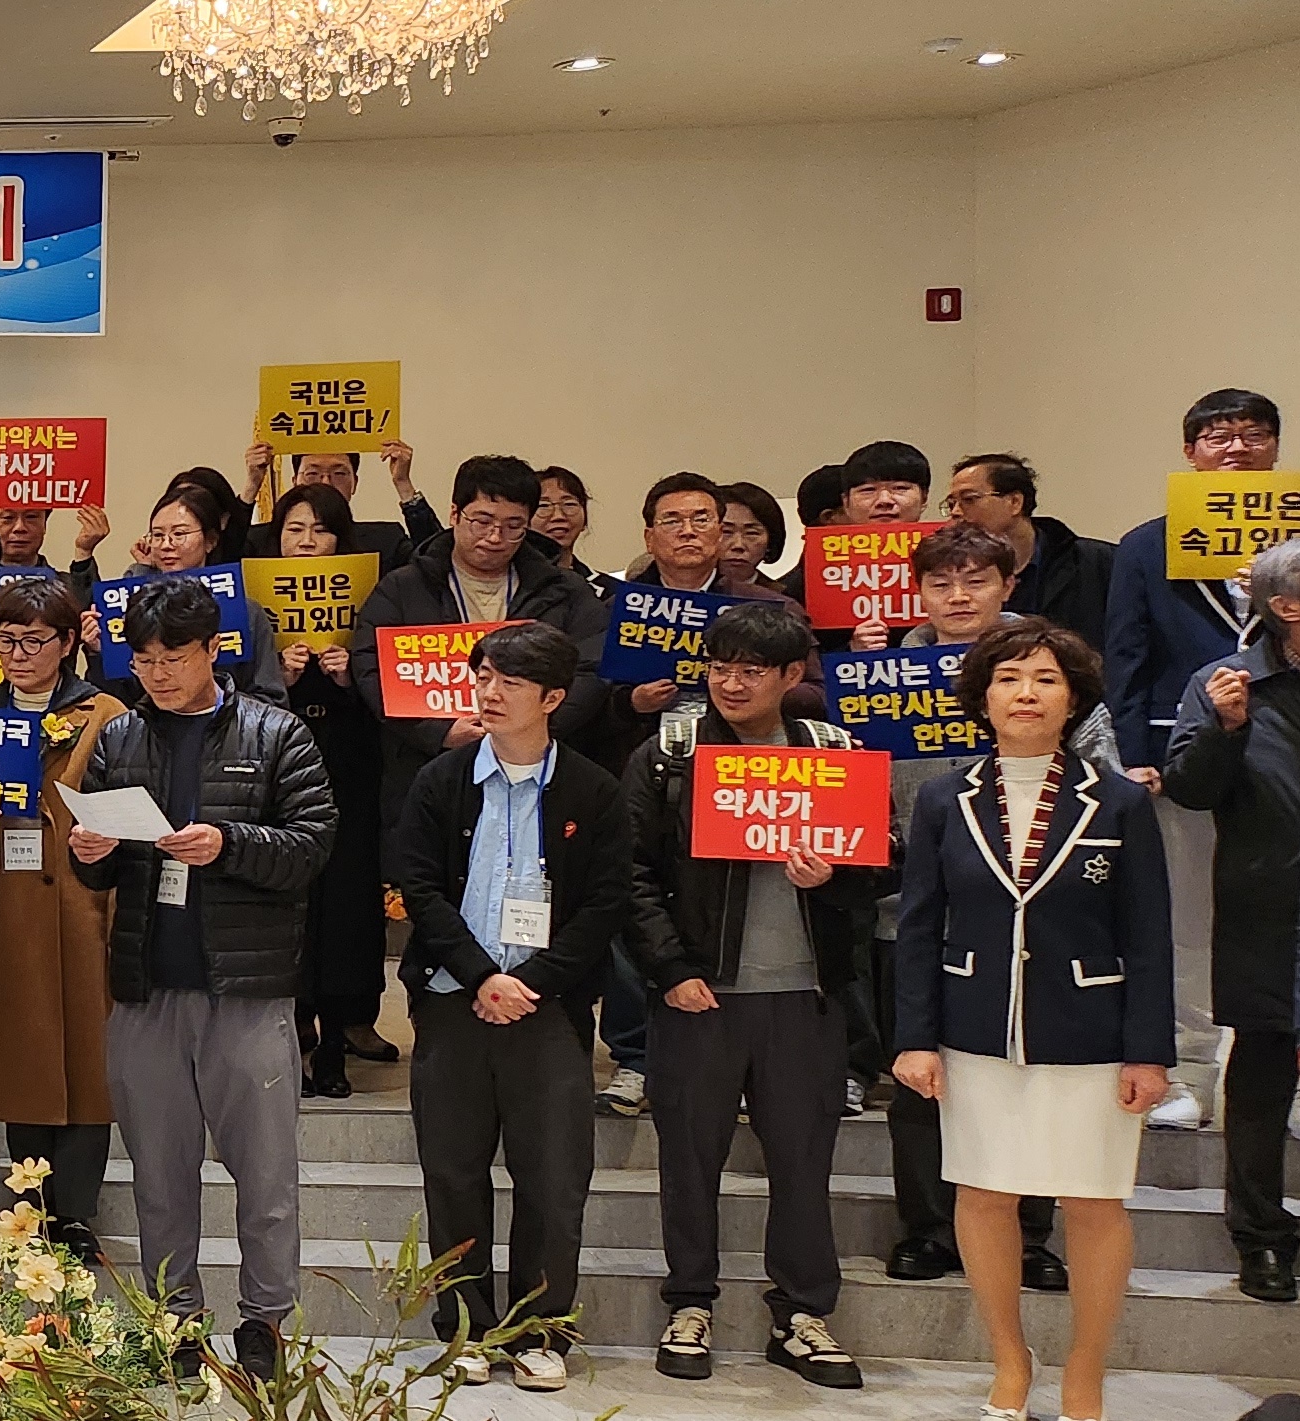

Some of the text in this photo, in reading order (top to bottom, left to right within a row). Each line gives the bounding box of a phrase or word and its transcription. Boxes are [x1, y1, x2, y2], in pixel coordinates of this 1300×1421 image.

[290, 380, 366, 405] 국민은
[270, 409, 390, 436] 속고있다!
[8, 480, 89, 503] 아니다!
[274, 574, 351, 601] 국민은
[823, 563, 911, 591] 약사가
[626, 593, 707, 626] 약사는
[836, 658, 930, 689] 약사는
[716, 756, 846, 787] 한약사는
[714, 789, 813, 820] 약사가
[746, 825, 864, 859] 아니다!
